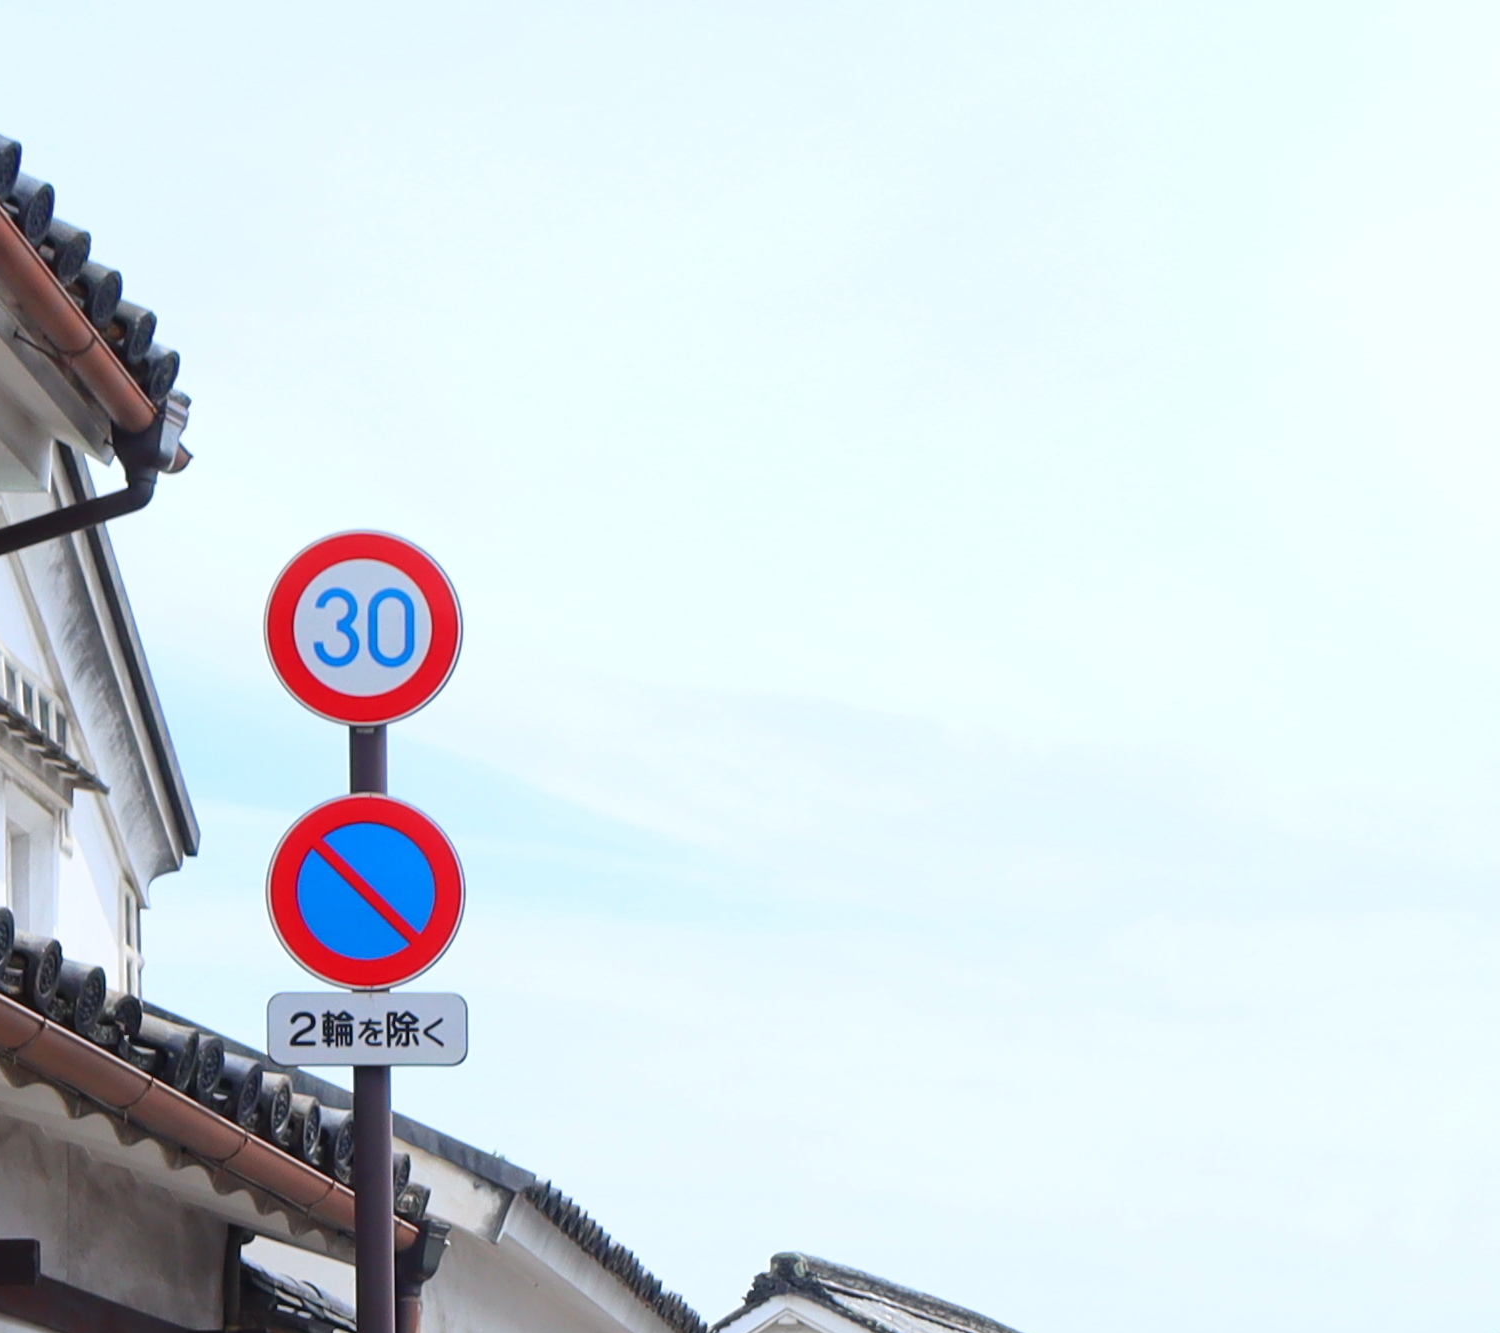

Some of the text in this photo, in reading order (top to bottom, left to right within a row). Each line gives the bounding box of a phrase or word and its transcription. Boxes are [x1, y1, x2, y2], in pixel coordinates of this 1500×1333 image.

[314, 588, 416, 667] 30
[289, 1012, 445, 1048] 2輪を除く
